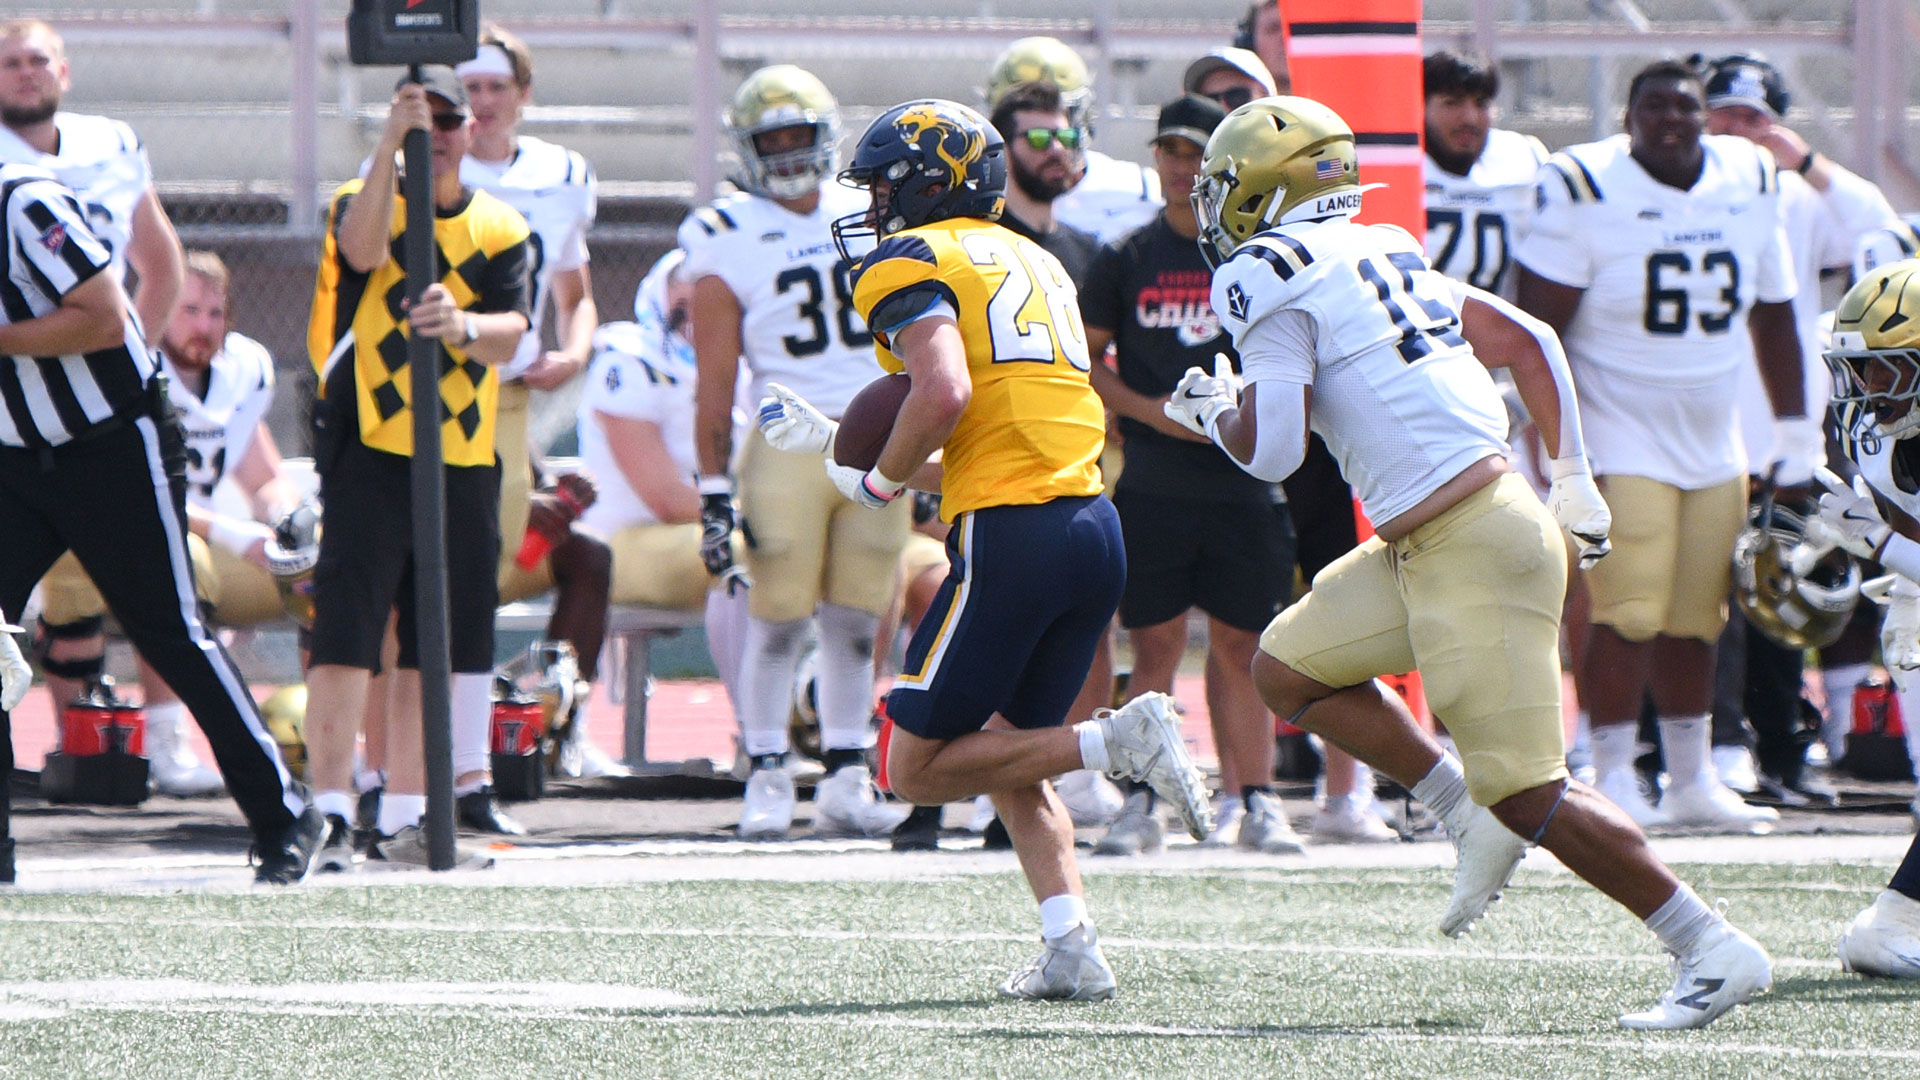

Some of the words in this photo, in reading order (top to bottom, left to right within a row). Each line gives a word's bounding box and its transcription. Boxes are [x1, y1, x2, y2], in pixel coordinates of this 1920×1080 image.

[1426, 209, 1508, 294] 70
[1645, 249, 1741, 335] 63
[776, 256, 875, 357] 38
[962, 234, 1092, 373] 28
[1356, 252, 1466, 365] 15
